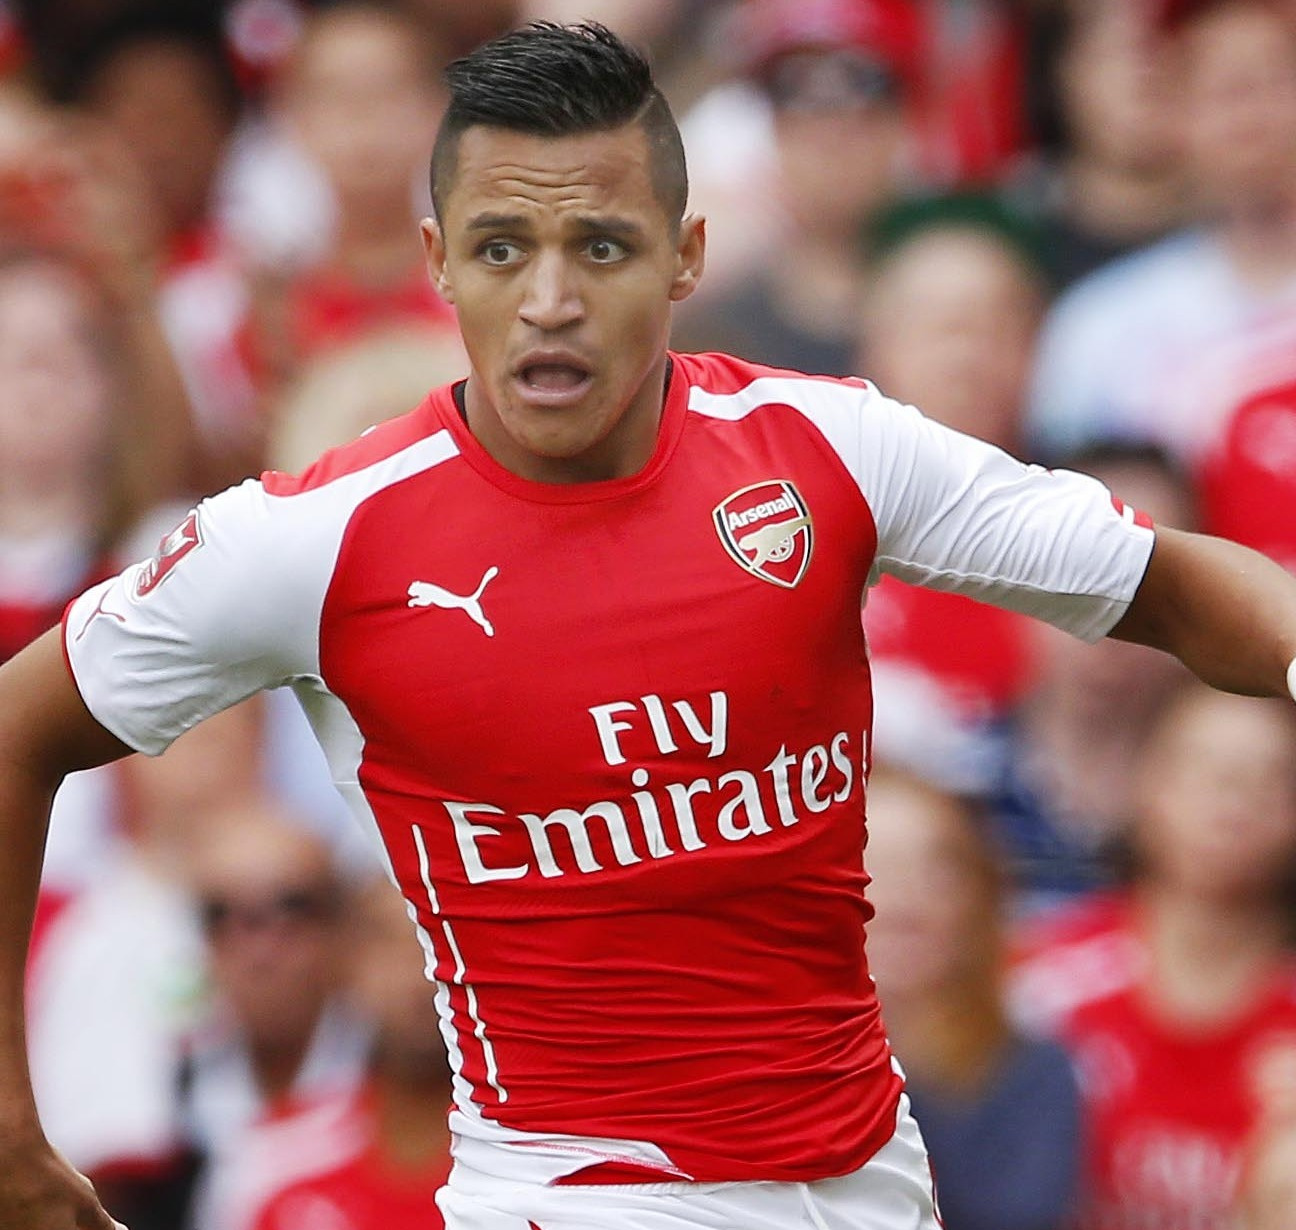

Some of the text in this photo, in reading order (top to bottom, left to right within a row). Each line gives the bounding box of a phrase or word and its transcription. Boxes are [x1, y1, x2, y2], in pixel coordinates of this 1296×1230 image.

[728, 492, 795, 531] Arsenal
[588, 691, 728, 766] Fly
[442, 731, 854, 885] Emirates
